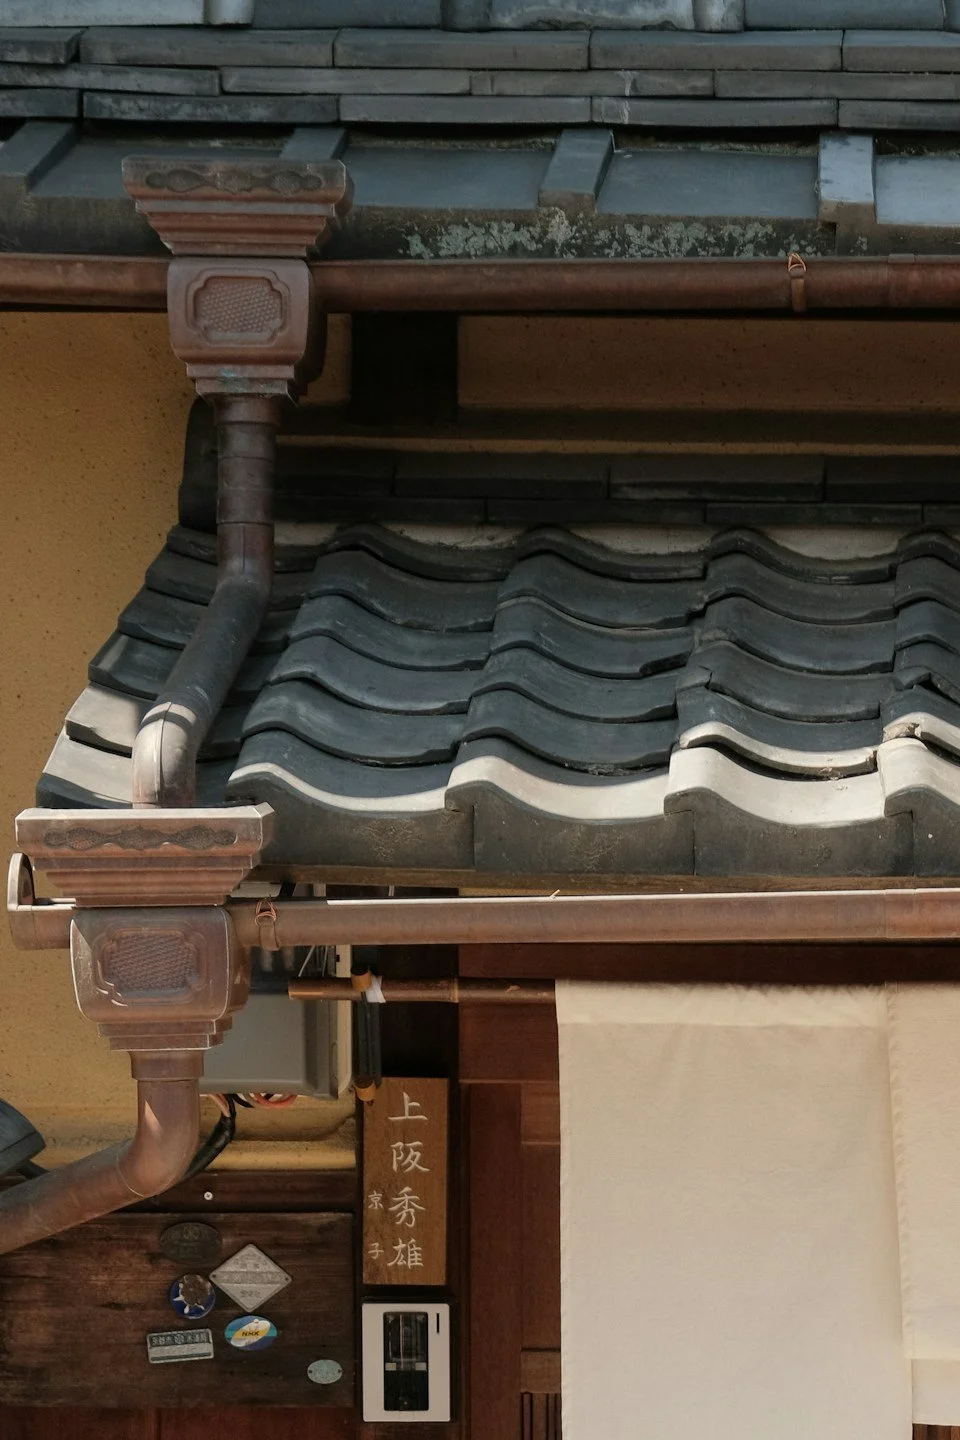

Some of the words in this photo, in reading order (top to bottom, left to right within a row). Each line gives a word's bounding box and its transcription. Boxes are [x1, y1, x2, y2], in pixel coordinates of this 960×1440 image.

[367, 1189, 385, 1260] 京子
[387, 1091, 430, 1270] 上阪秀雄
